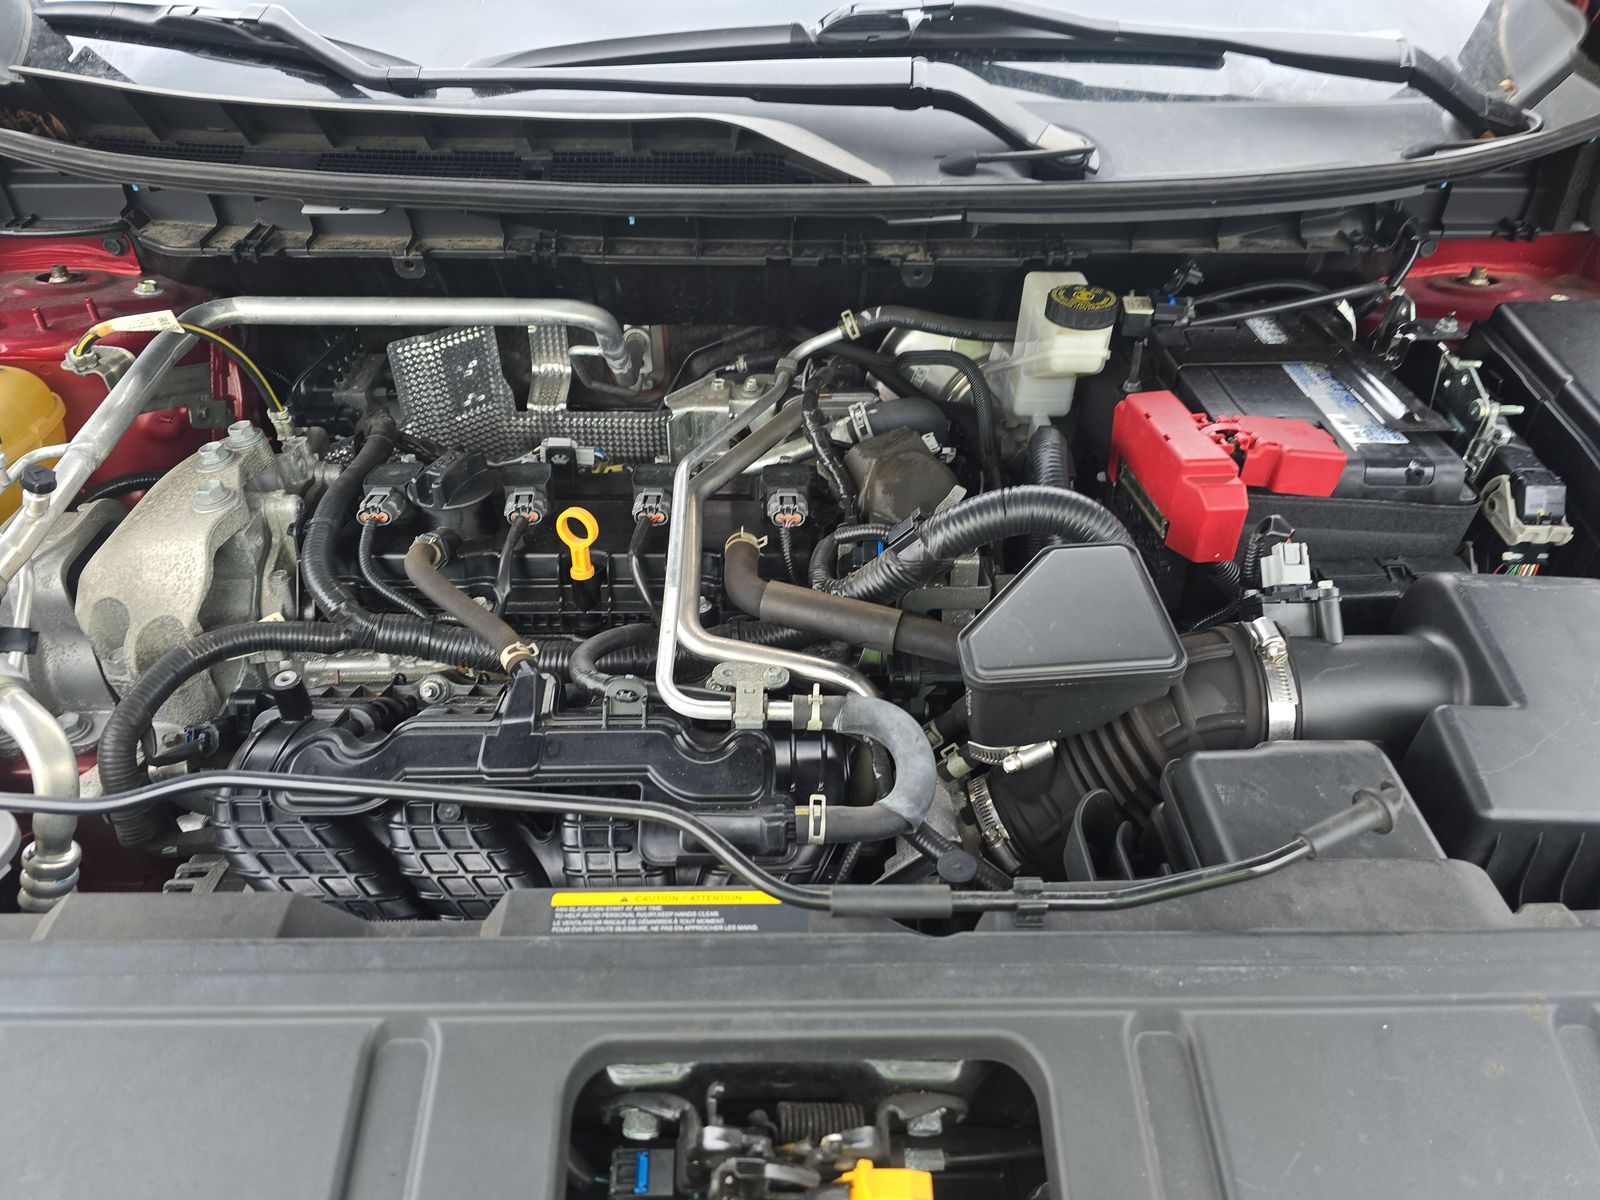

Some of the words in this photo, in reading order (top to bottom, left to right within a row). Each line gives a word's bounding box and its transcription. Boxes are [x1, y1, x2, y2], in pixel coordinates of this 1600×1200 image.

[689, 894, 742, 902] ATTENTION
[580, 911, 602, 919] AVOID
[602, 911, 635, 919] PERSONAL
